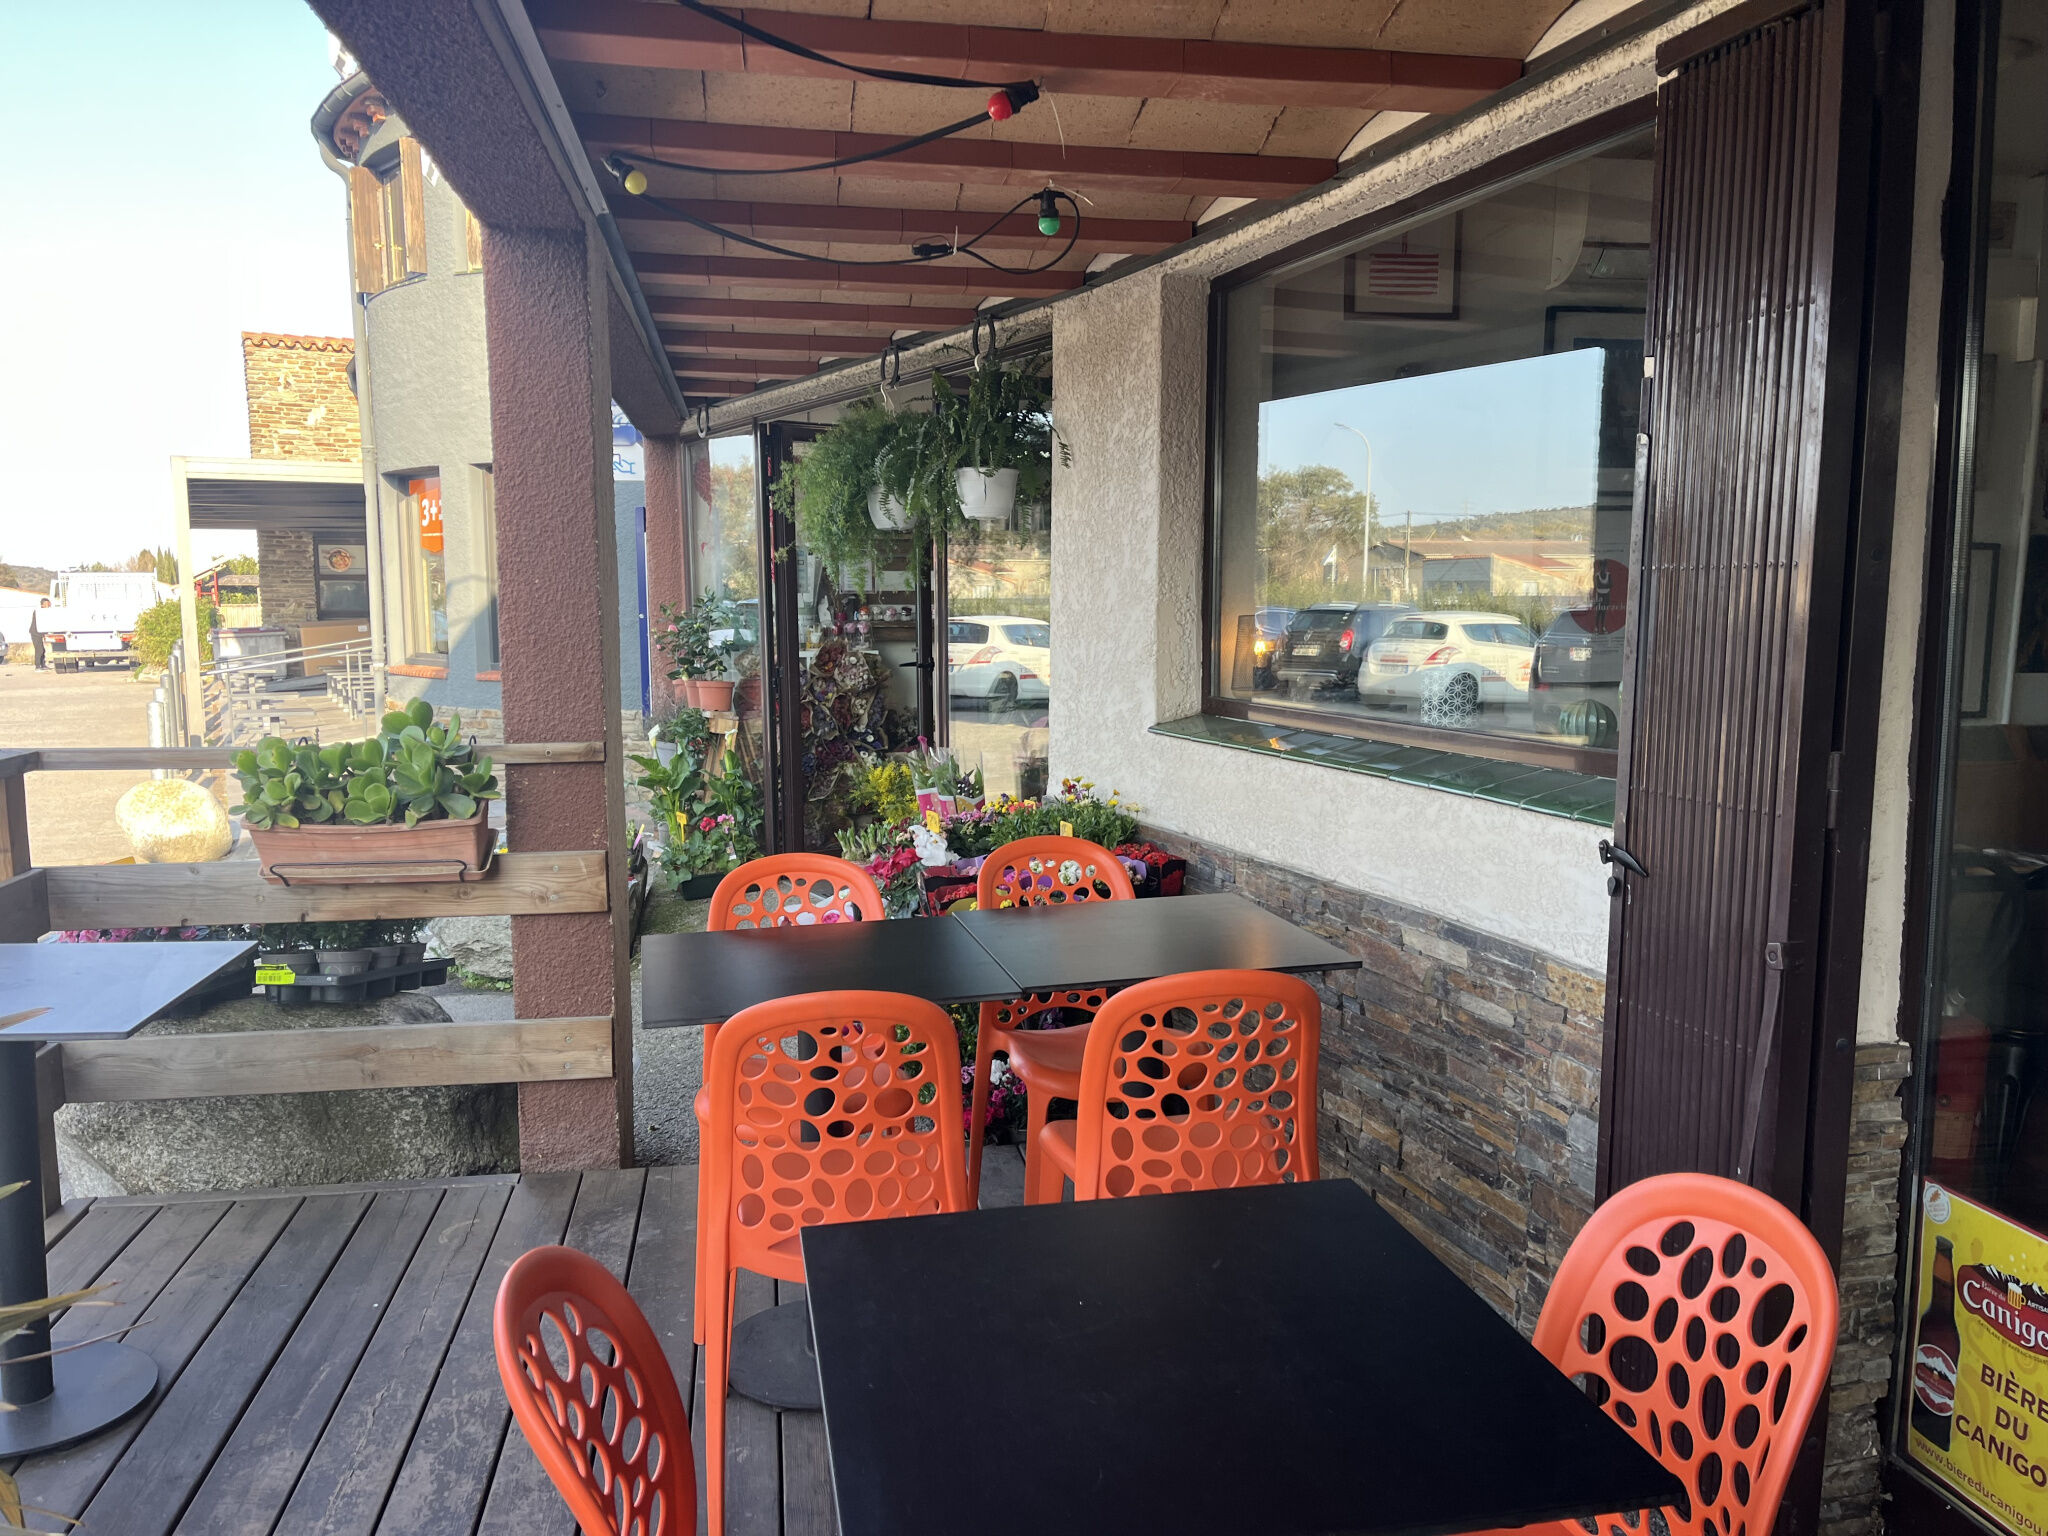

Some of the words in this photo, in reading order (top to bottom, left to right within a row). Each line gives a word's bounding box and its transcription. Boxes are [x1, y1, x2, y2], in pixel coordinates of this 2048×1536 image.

[1963, 1280, 2048, 1351] Canigo
[1981, 1363, 2048, 1424] BIÈRE
[1995, 1405, 2028, 1441] DU
[1914, 1436, 2048, 1536] www.biereducanigou
[1955, 1415, 2047, 1488] CANIGO
